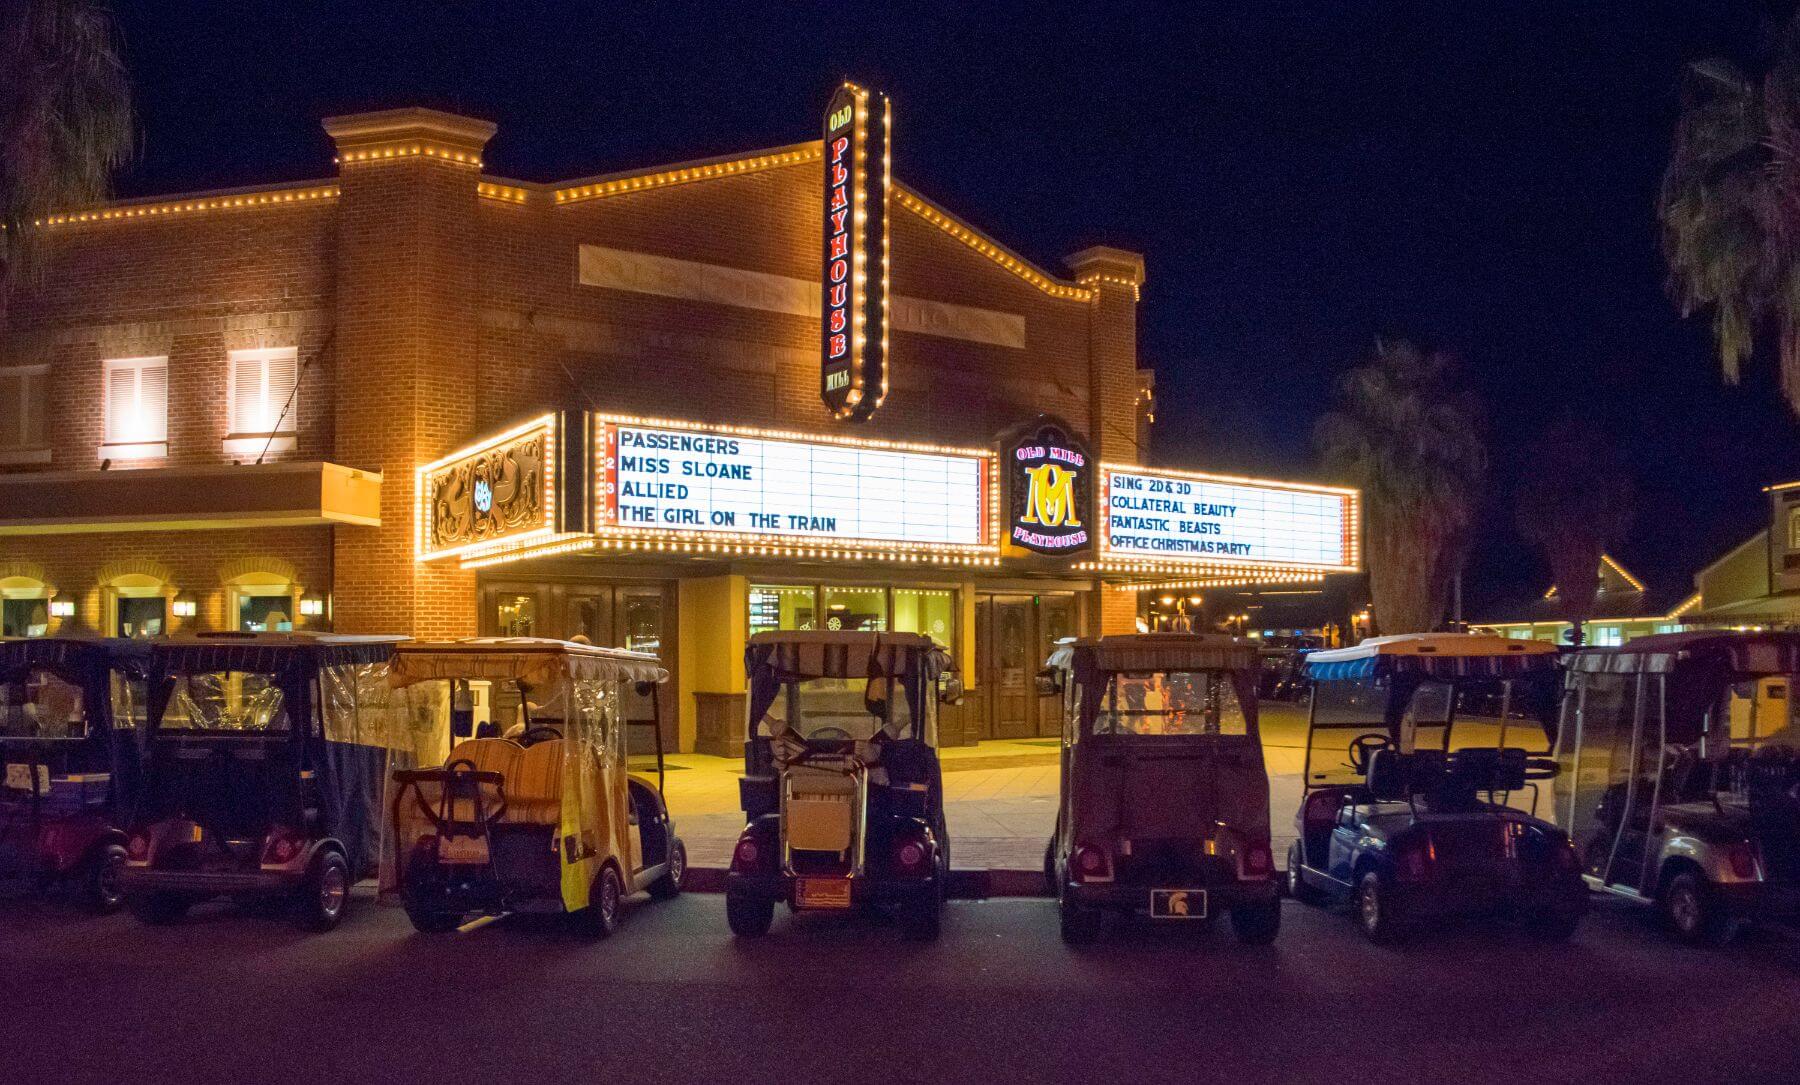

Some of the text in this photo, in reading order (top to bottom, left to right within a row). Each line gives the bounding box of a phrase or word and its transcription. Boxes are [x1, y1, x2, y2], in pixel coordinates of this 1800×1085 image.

[829, 105, 852, 132] OLD
[830, 137, 848, 359] PLAYHOUSE
[608, 433, 613, 444] 1
[621, 431, 739, 455] PASSENGERS
[606, 457, 615, 469] 2
[1016, 446, 1085, 466] OLD MILL
[621, 457, 752, 480] MISS SLOANE
[606, 483, 615, 493] 3
[622, 481, 688, 500] ALLIED
[1113, 476, 1142, 491] SING
[1176, 482, 1191, 495] 3D
[606, 508, 615, 518] 4
[1111, 495, 1186, 514] COLLATERAL
[1193, 502, 1236, 518] BEAUTY
[619, 505, 836, 532] THE GIRL ON THE TRAIN
[1111, 516, 1221, 536] FANTASTIC BEASTS
[1013, 526, 1088, 547] PLAYHOUSE
[1110, 535, 1150, 550] OFFICE
[1151, 538, 1214, 553] CHRISTMAS
[1215, 541, 1251, 556] PARTY
